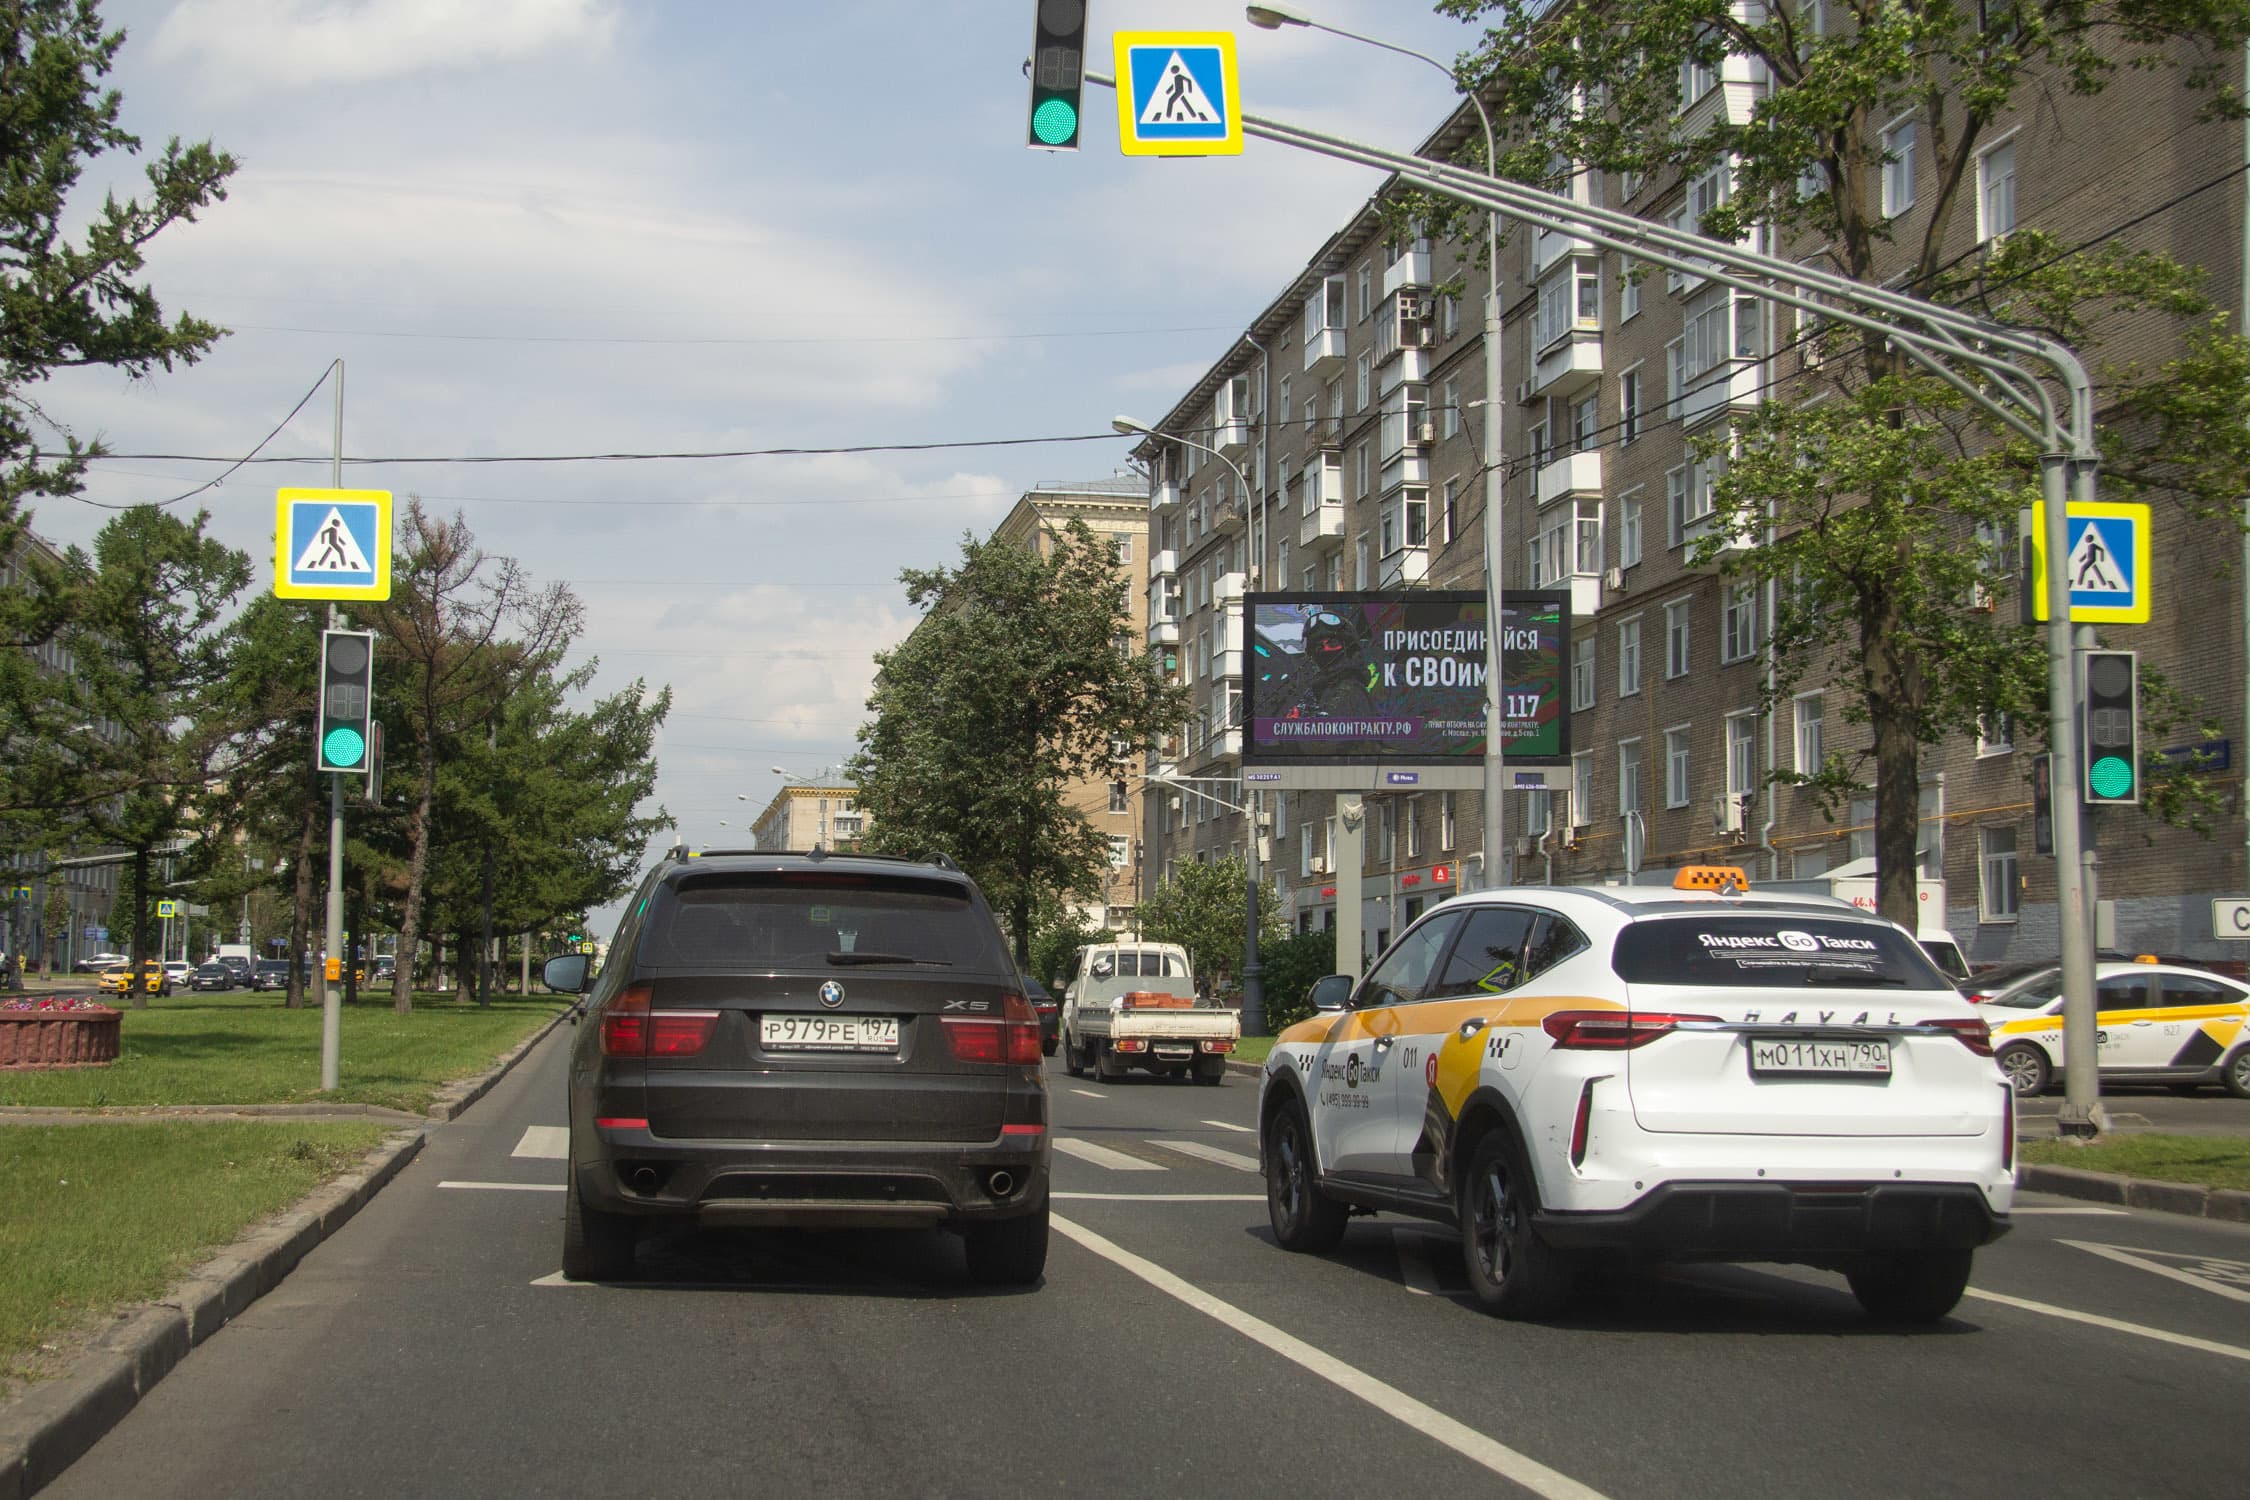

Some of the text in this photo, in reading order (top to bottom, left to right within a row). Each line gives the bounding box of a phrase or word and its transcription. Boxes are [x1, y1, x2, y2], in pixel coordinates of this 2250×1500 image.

[1384, 626, 1538, 652] ПРИСОЕДИНЙСЯ
[1506, 695, 1540, 718] 117
[1273, 721, 1412, 735] СЛУЖБАПОКОНТРАКТУ.РФ
[1698, 934, 1877, 950] Яндекс Go Такси
[943, 1000, 990, 1011] X5
[1744, 1010, 1900, 1025] HAVAL
[861, 1019, 892, 1036] 197
[1403, 1048, 1417, 1068] 011
[1850, 1043, 1883, 1062] 790
[1321, 1059, 1346, 1082] Яндекс
[1360, 1061, 1380, 1083] Такси
